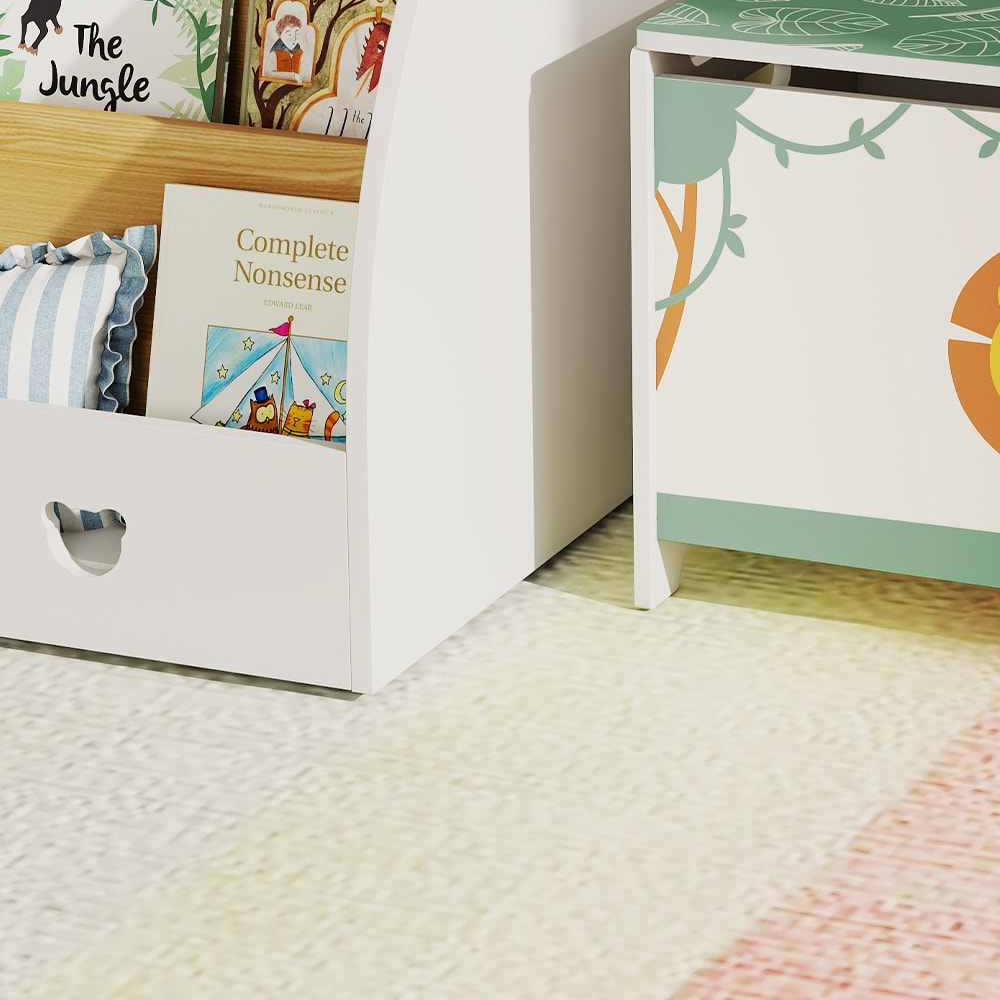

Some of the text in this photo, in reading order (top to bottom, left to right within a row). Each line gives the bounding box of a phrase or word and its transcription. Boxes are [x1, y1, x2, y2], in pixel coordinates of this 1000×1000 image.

[74, 22, 122, 61] The
[39, 60, 150, 112] Jungle
[352, 110, 365, 124] the
[236, 228, 349, 263] Complete
[233, 260, 347, 294] Nonsense
[263, 299, 313, 311] EDWARD LEAR
